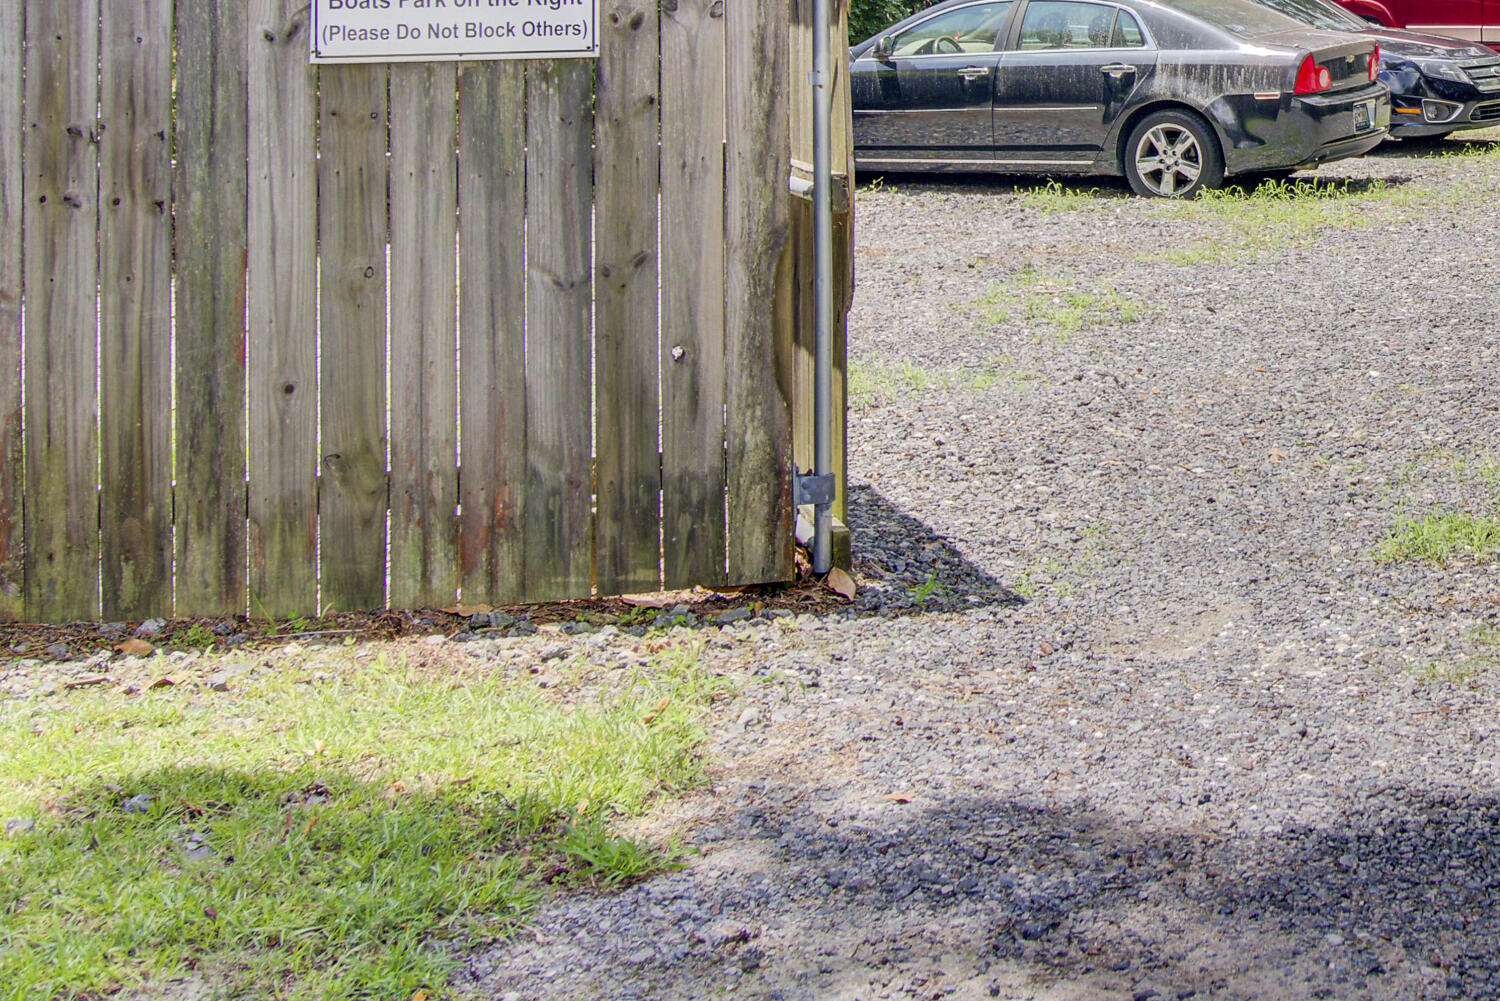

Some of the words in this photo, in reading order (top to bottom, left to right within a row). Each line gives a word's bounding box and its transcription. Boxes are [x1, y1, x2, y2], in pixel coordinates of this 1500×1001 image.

[323, 26, 389, 45] (Please
[397, 24, 420, 39] Do
[429, 24, 458, 38] Not
[466, 22, 515, 37] Block
[522, 20, 587, 39] Others)
